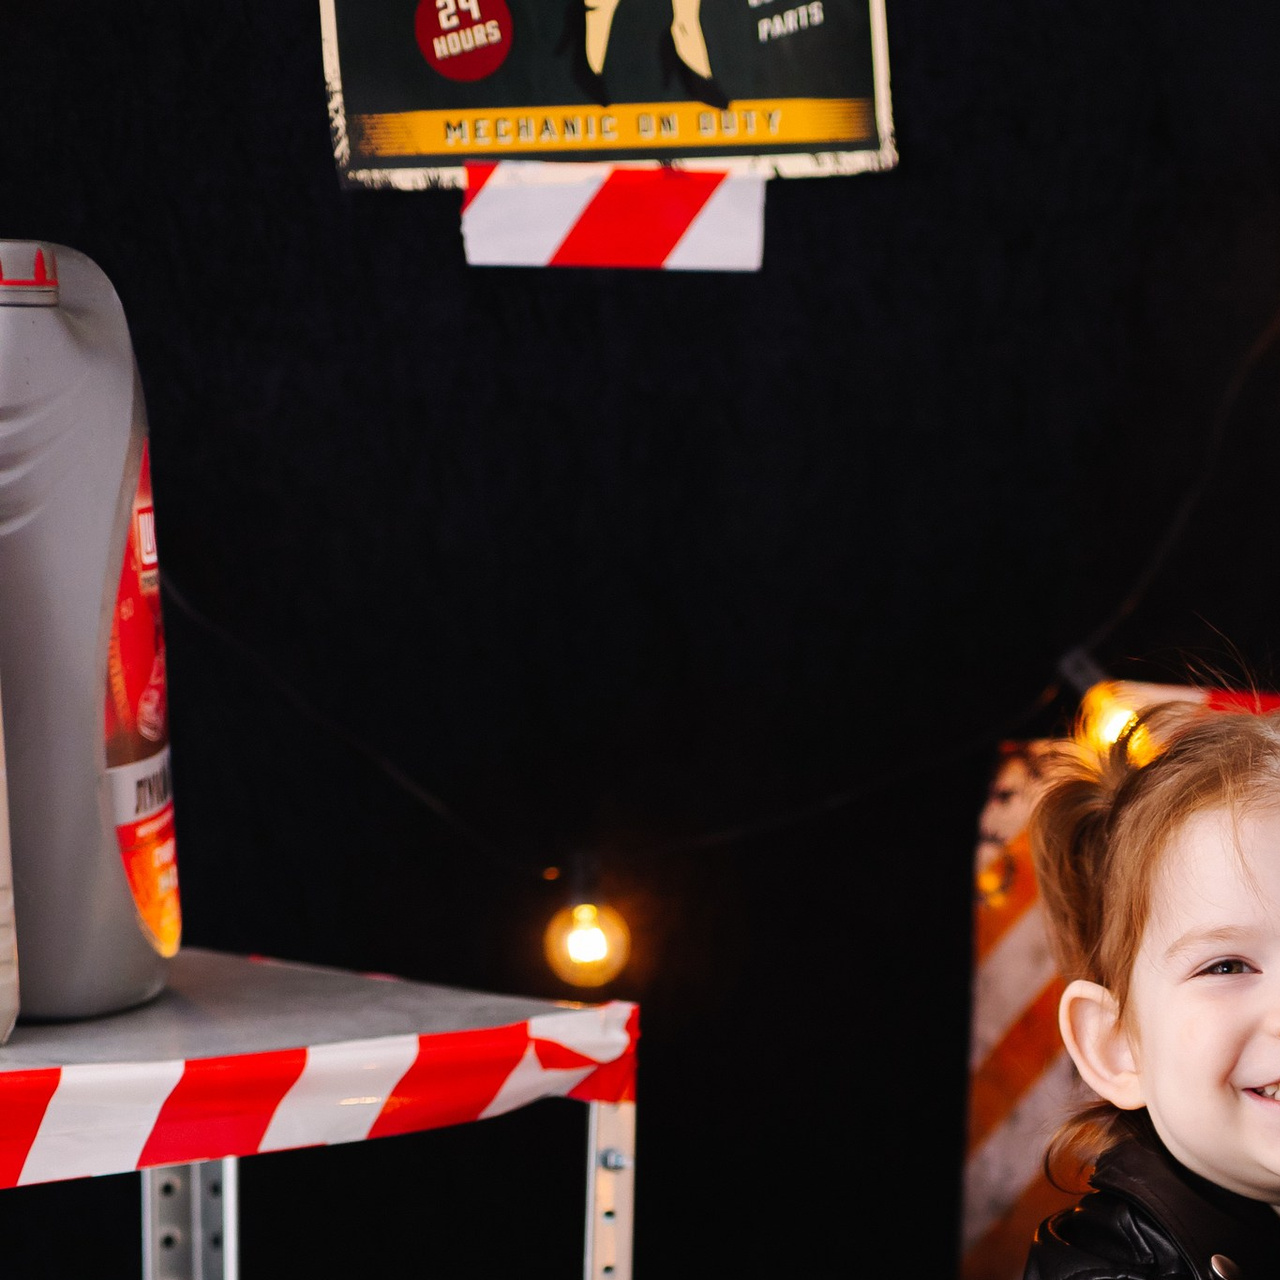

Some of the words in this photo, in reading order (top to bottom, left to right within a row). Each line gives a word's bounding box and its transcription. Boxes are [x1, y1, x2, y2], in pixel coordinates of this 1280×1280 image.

[435, 0, 482, 30] 24
[757, 1, 824, 42] PARTS
[432, 19, 502, 60] HOURS
[444, 113, 619, 147] MECHANIC
[638, 112, 680, 139] ON
[699, 108, 782, 138] DUTY
